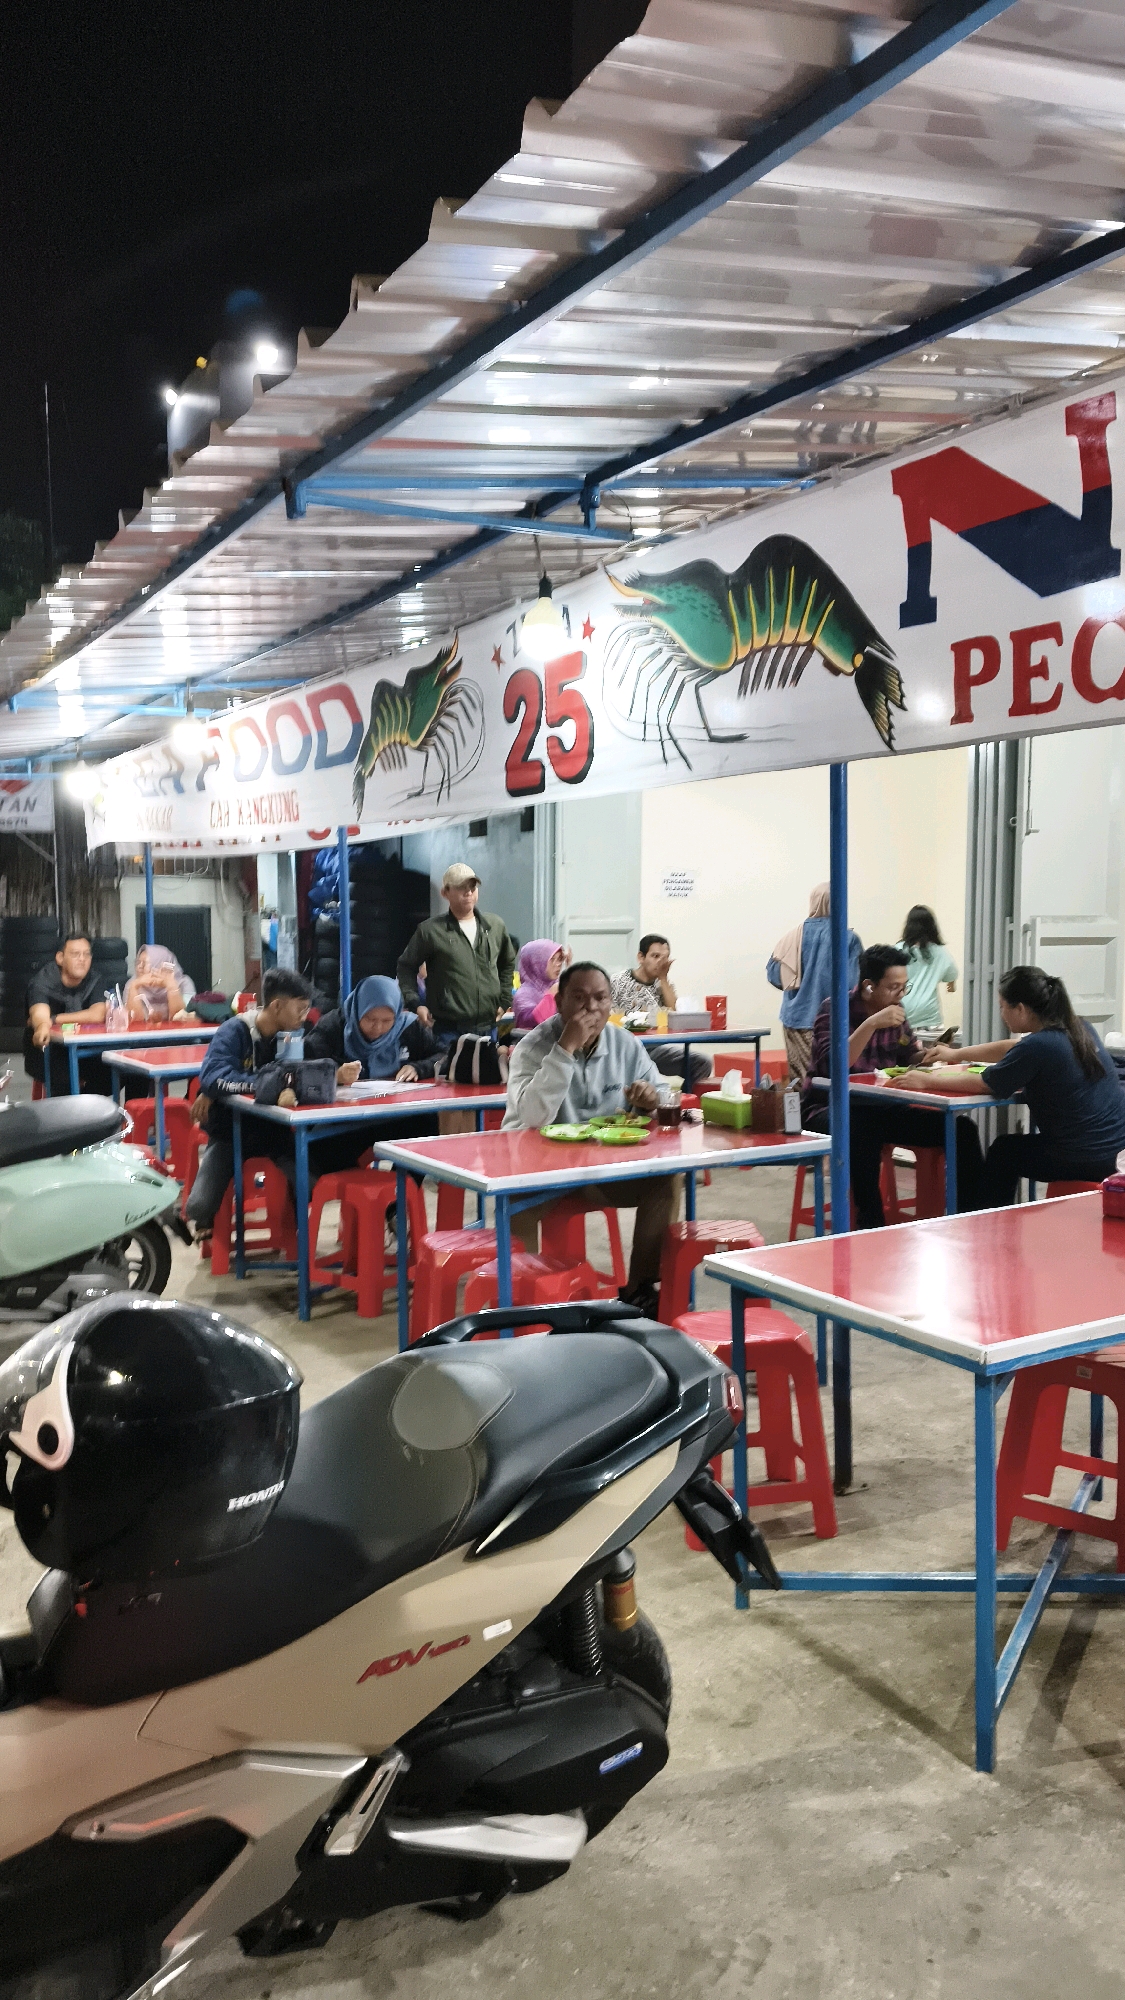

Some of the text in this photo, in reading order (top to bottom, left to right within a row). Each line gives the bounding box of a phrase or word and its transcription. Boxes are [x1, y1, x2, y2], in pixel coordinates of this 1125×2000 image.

[503, 650, 594, 797] 25
[210, 799, 230, 829] CAH
[238, 788, 299, 826] KANGKUNG
[227, 1480, 284, 1513] HONDA
